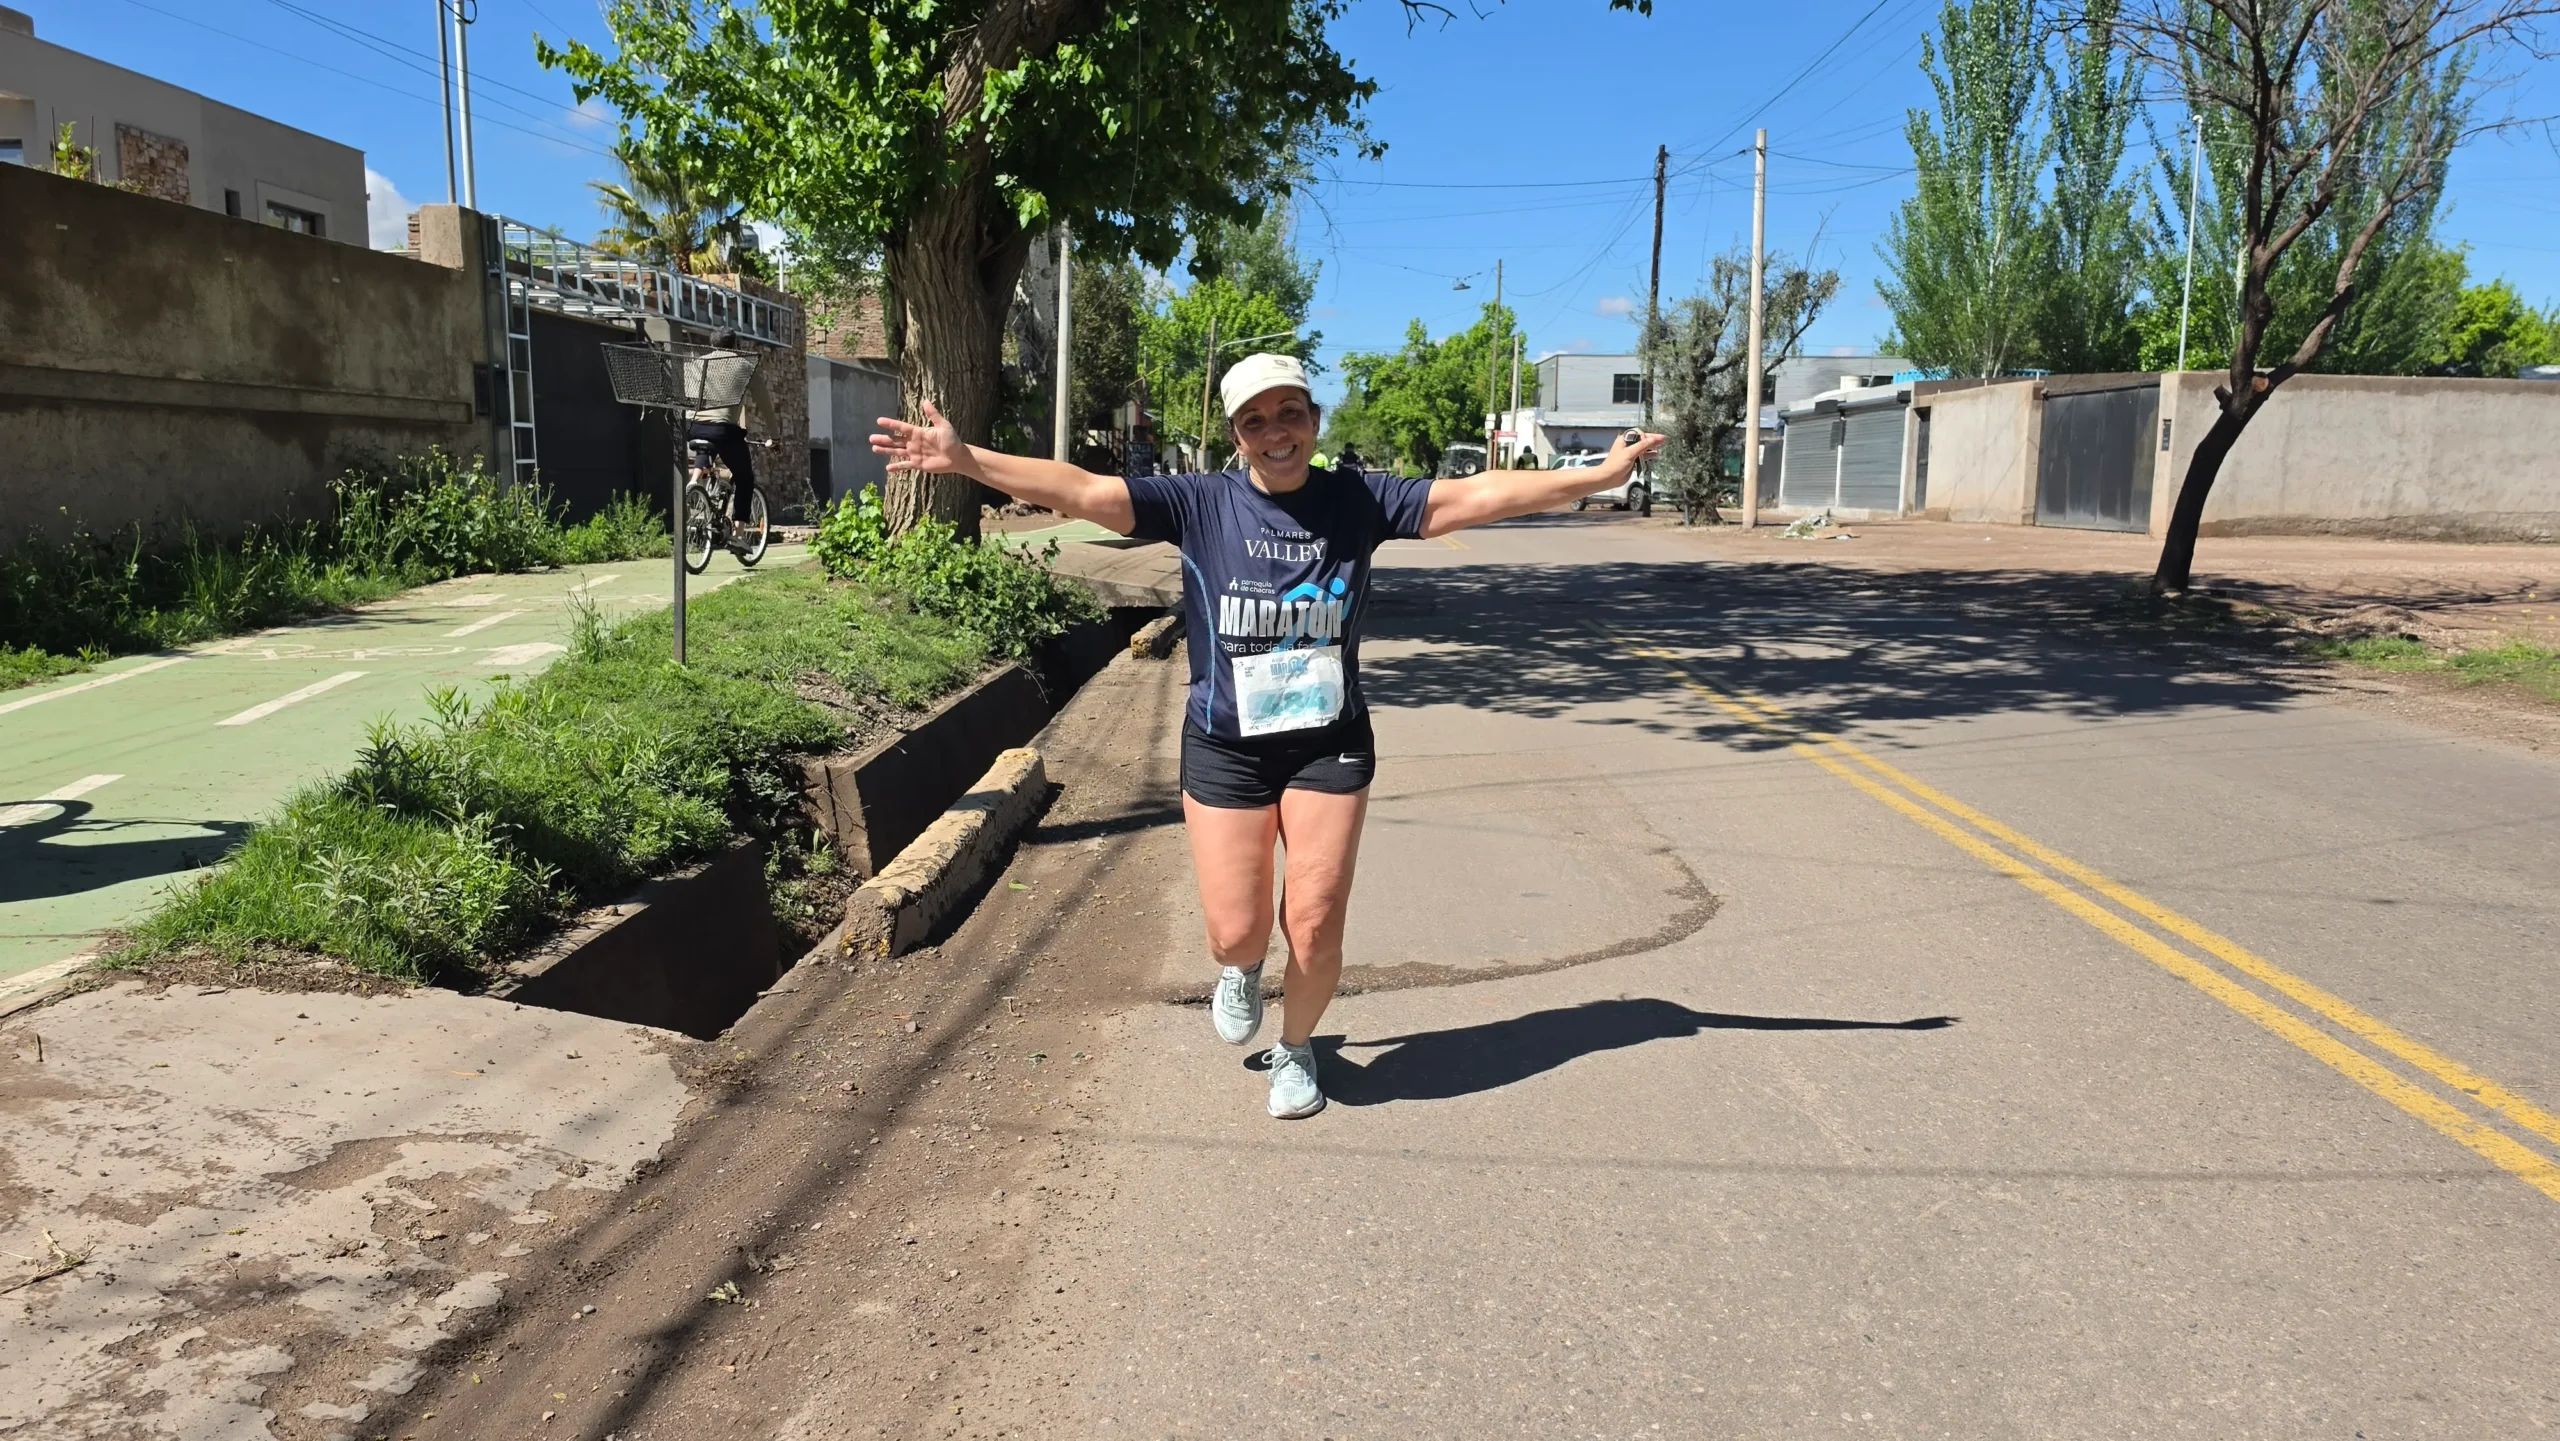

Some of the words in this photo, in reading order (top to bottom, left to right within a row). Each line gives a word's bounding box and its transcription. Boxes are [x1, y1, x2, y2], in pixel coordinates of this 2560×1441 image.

[1260, 527, 1311, 539] PALMARES
[1244, 539, 1326, 562] VALLEY
[1241, 580, 1273, 588] parroquia
[1250, 586, 1276, 594] chacras
[1249, 641, 1280, 653] toda
[1283, 641, 1294, 652] la
